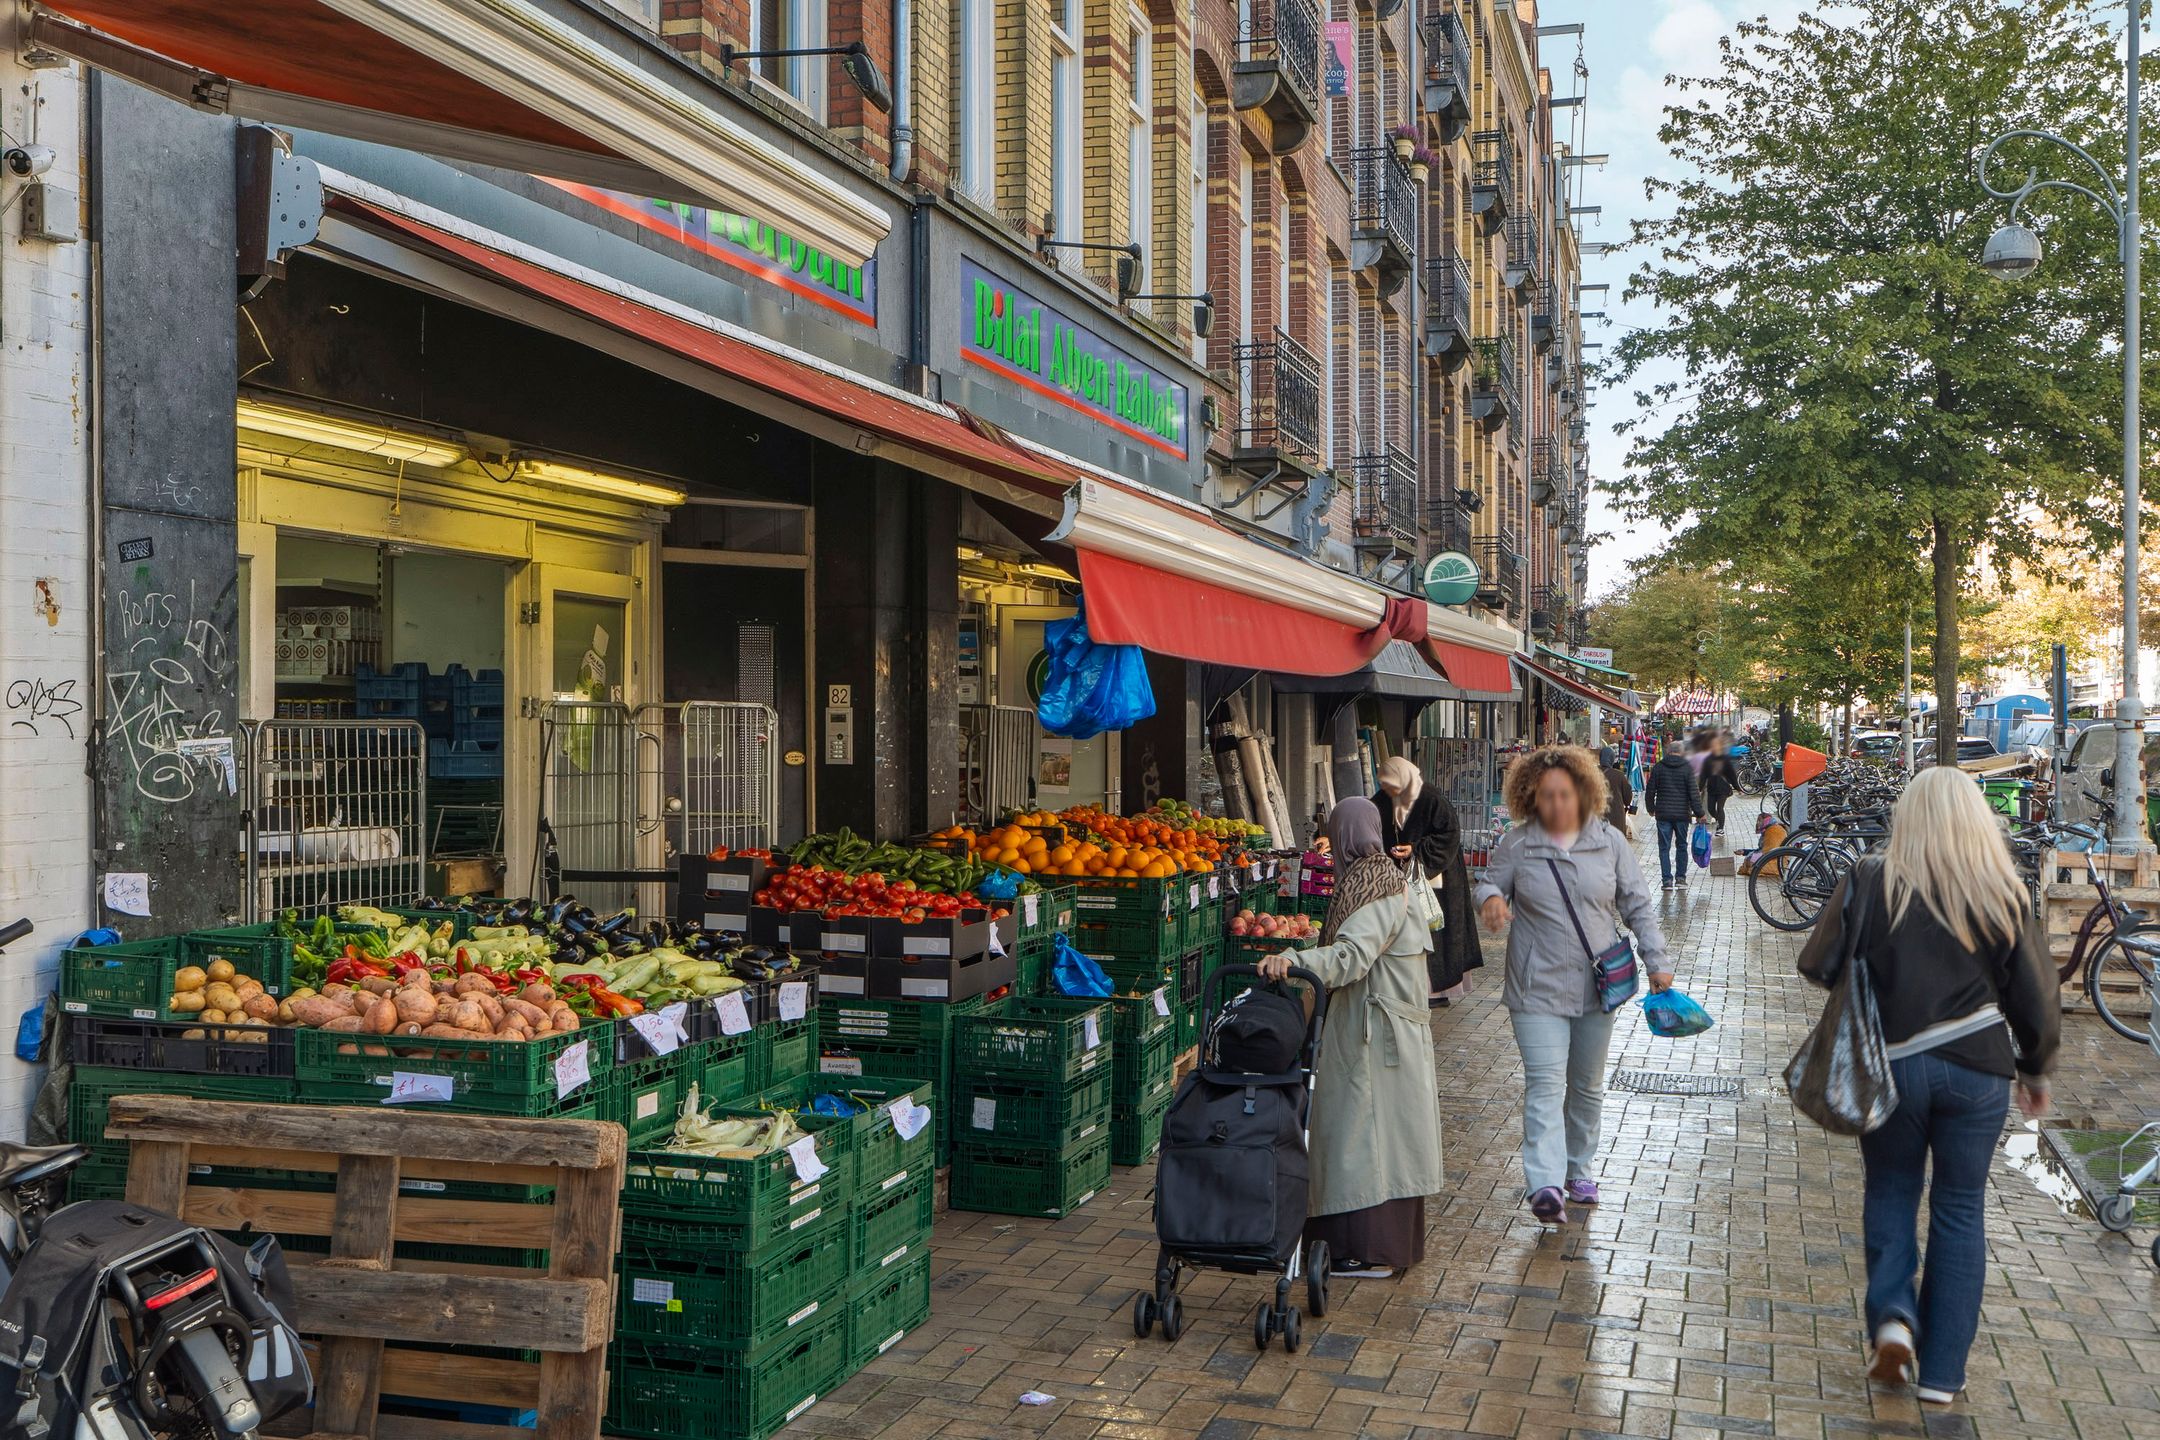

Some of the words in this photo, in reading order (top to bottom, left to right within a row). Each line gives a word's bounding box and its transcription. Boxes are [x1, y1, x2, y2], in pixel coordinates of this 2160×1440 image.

[974, 277, 1041, 375] Bilal
[1048, 322, 1110, 410] Aben
[1115, 358, 1180, 443] Rabah
[831, 688, 848, 704] 82
